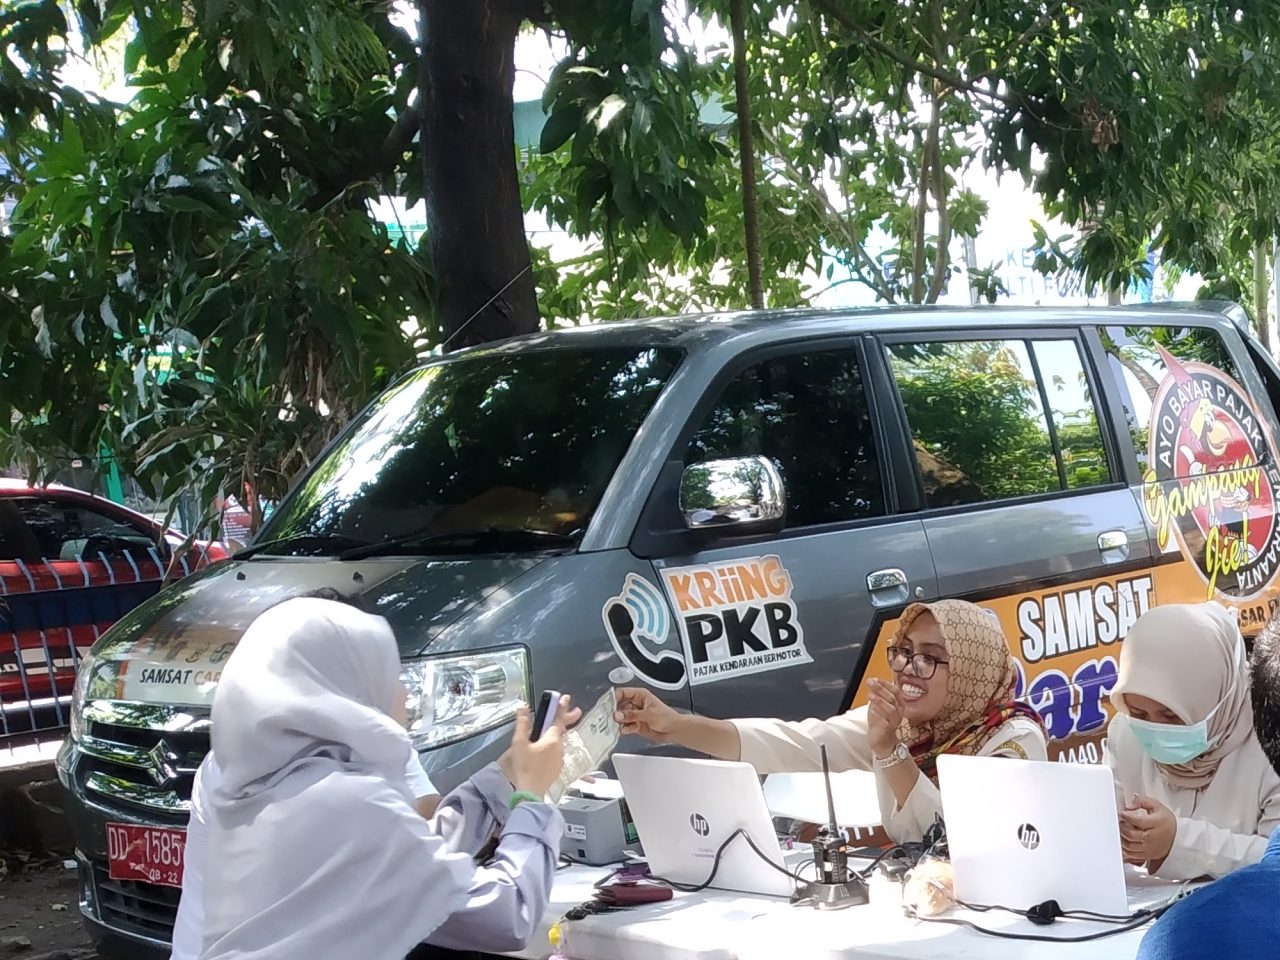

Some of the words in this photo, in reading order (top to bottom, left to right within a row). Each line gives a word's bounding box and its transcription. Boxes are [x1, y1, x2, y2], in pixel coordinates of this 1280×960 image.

[1159, 415, 1175, 469] AYO
[1169, 380, 1214, 417] BAYAR
[1216, 384, 1263, 448] PAJAK
[684, 602, 798, 664] PKB
[1020, 576, 1152, 661] SAMSAT
[140, 668, 193, 685] SAMSAT
[693, 664, 719, 678] PAJAK
[719, 655, 764, 673] KENDARAAN
[764, 648, 802, 664] BERMOTOR
[1015, 657, 1119, 740] ar
[691, 813, 709, 837] hp
[1018, 823, 1040, 850] hp
[108, 827, 129, 860] DD
[144, 830, 182, 867] 1585
